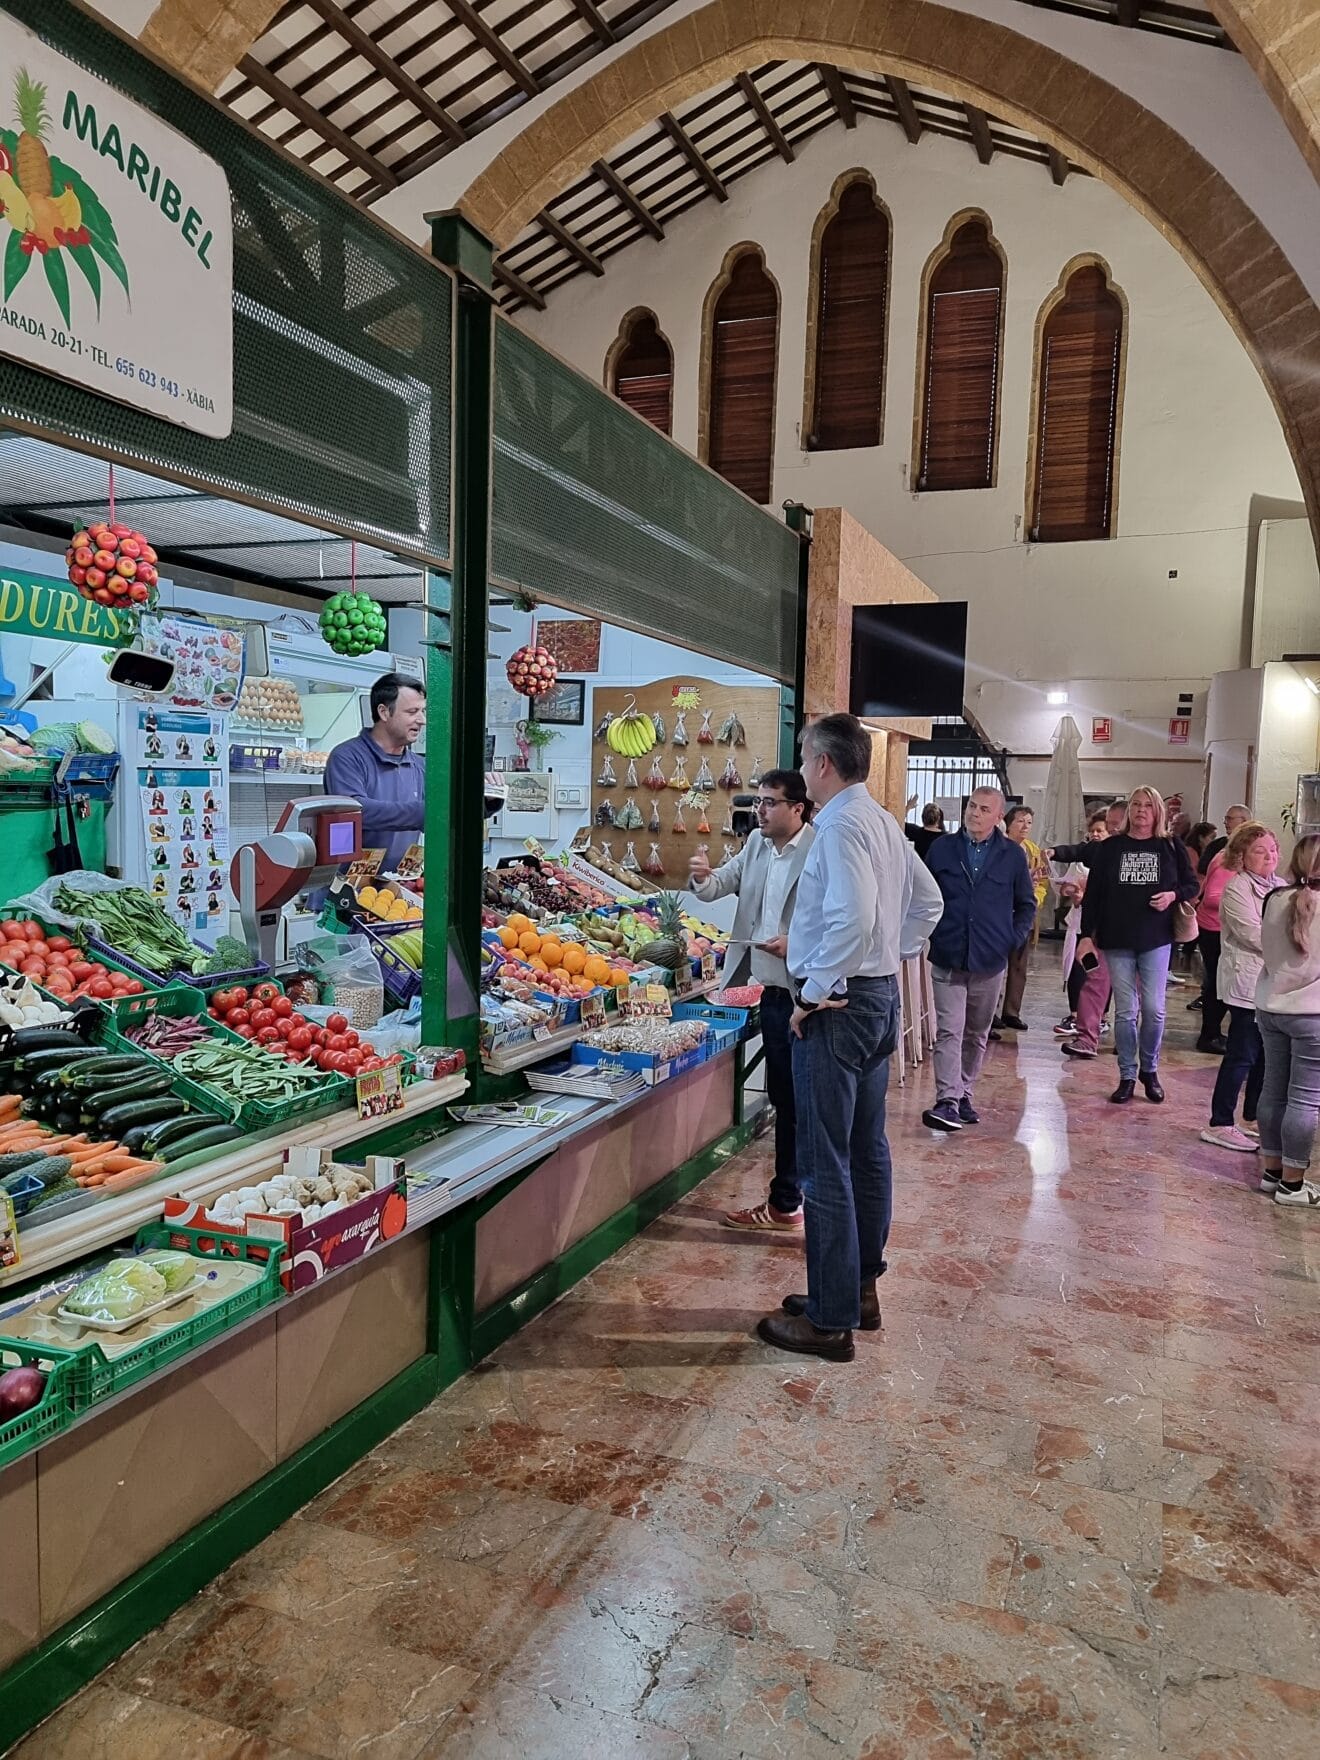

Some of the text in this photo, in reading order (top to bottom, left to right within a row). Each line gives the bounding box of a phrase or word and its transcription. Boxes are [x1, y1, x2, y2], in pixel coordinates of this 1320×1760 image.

[63, 90, 213, 270] MARIBEL
[0, 306, 47, 341] ARADA
[51, 328, 82, 355] 20-21
[91, 345, 113, 369] TEL.
[116, 357, 135, 378] 655
[139, 371, 157, 388] 623
[160, 377, 179, 398] 943
[572, 861, 605, 886] Kiwiberico
[1120, 872, 1158, 882] OPRESOR
